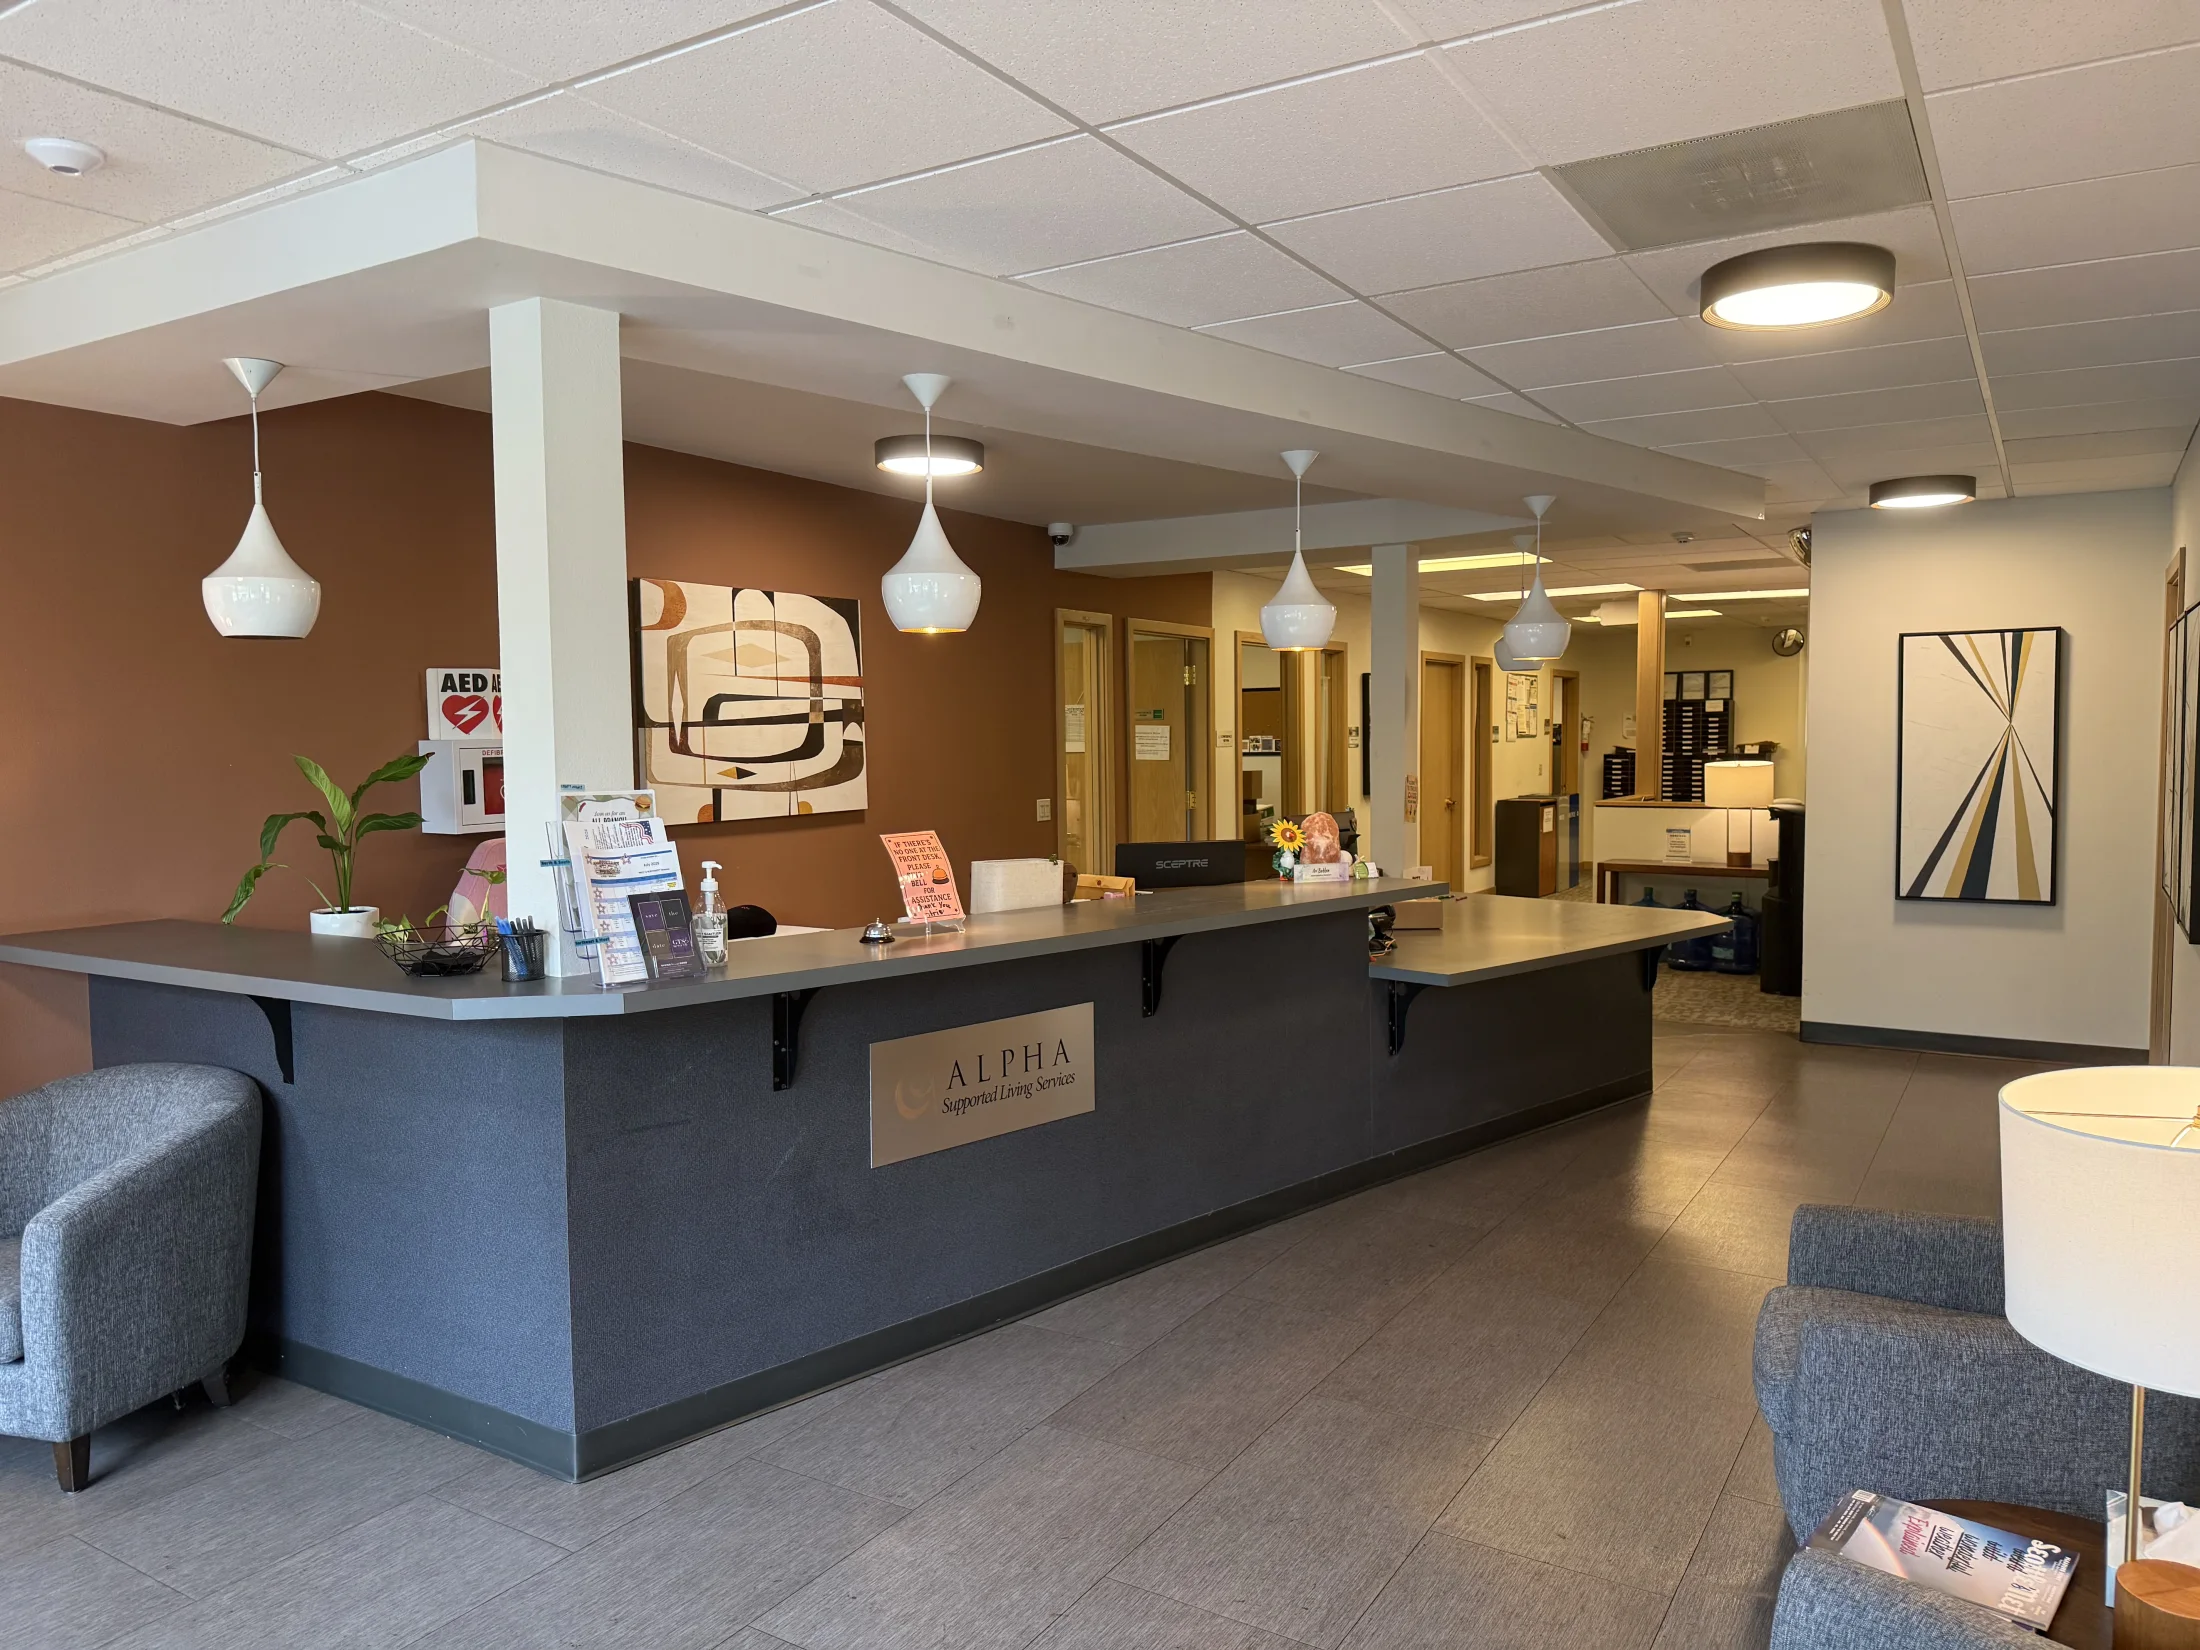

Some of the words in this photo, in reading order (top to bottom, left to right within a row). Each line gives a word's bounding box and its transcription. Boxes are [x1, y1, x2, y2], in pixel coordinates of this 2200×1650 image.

[440, 673, 488, 692] AED
[492, 673, 502, 692] AE
[898, 854, 921, 863] FRONT
[904, 847, 918, 855] ONE
[1155, 858, 1209, 870] SCEPTRE
[911, 879, 927, 887] BELL
[912, 894, 952, 903] ASSISTANCE
[946, 1038, 1071, 1091] ALPHA
[942, 1085, 997, 1116] Supported
[1000, 1081, 1033, 1099] Living
[1036, 1072, 1076, 1093] Services
[1899, 1515, 1930, 1558] Explained
[1928, 1526, 1955, 1560] weather
[1948, 1533, 1980, 1577] wonderful
